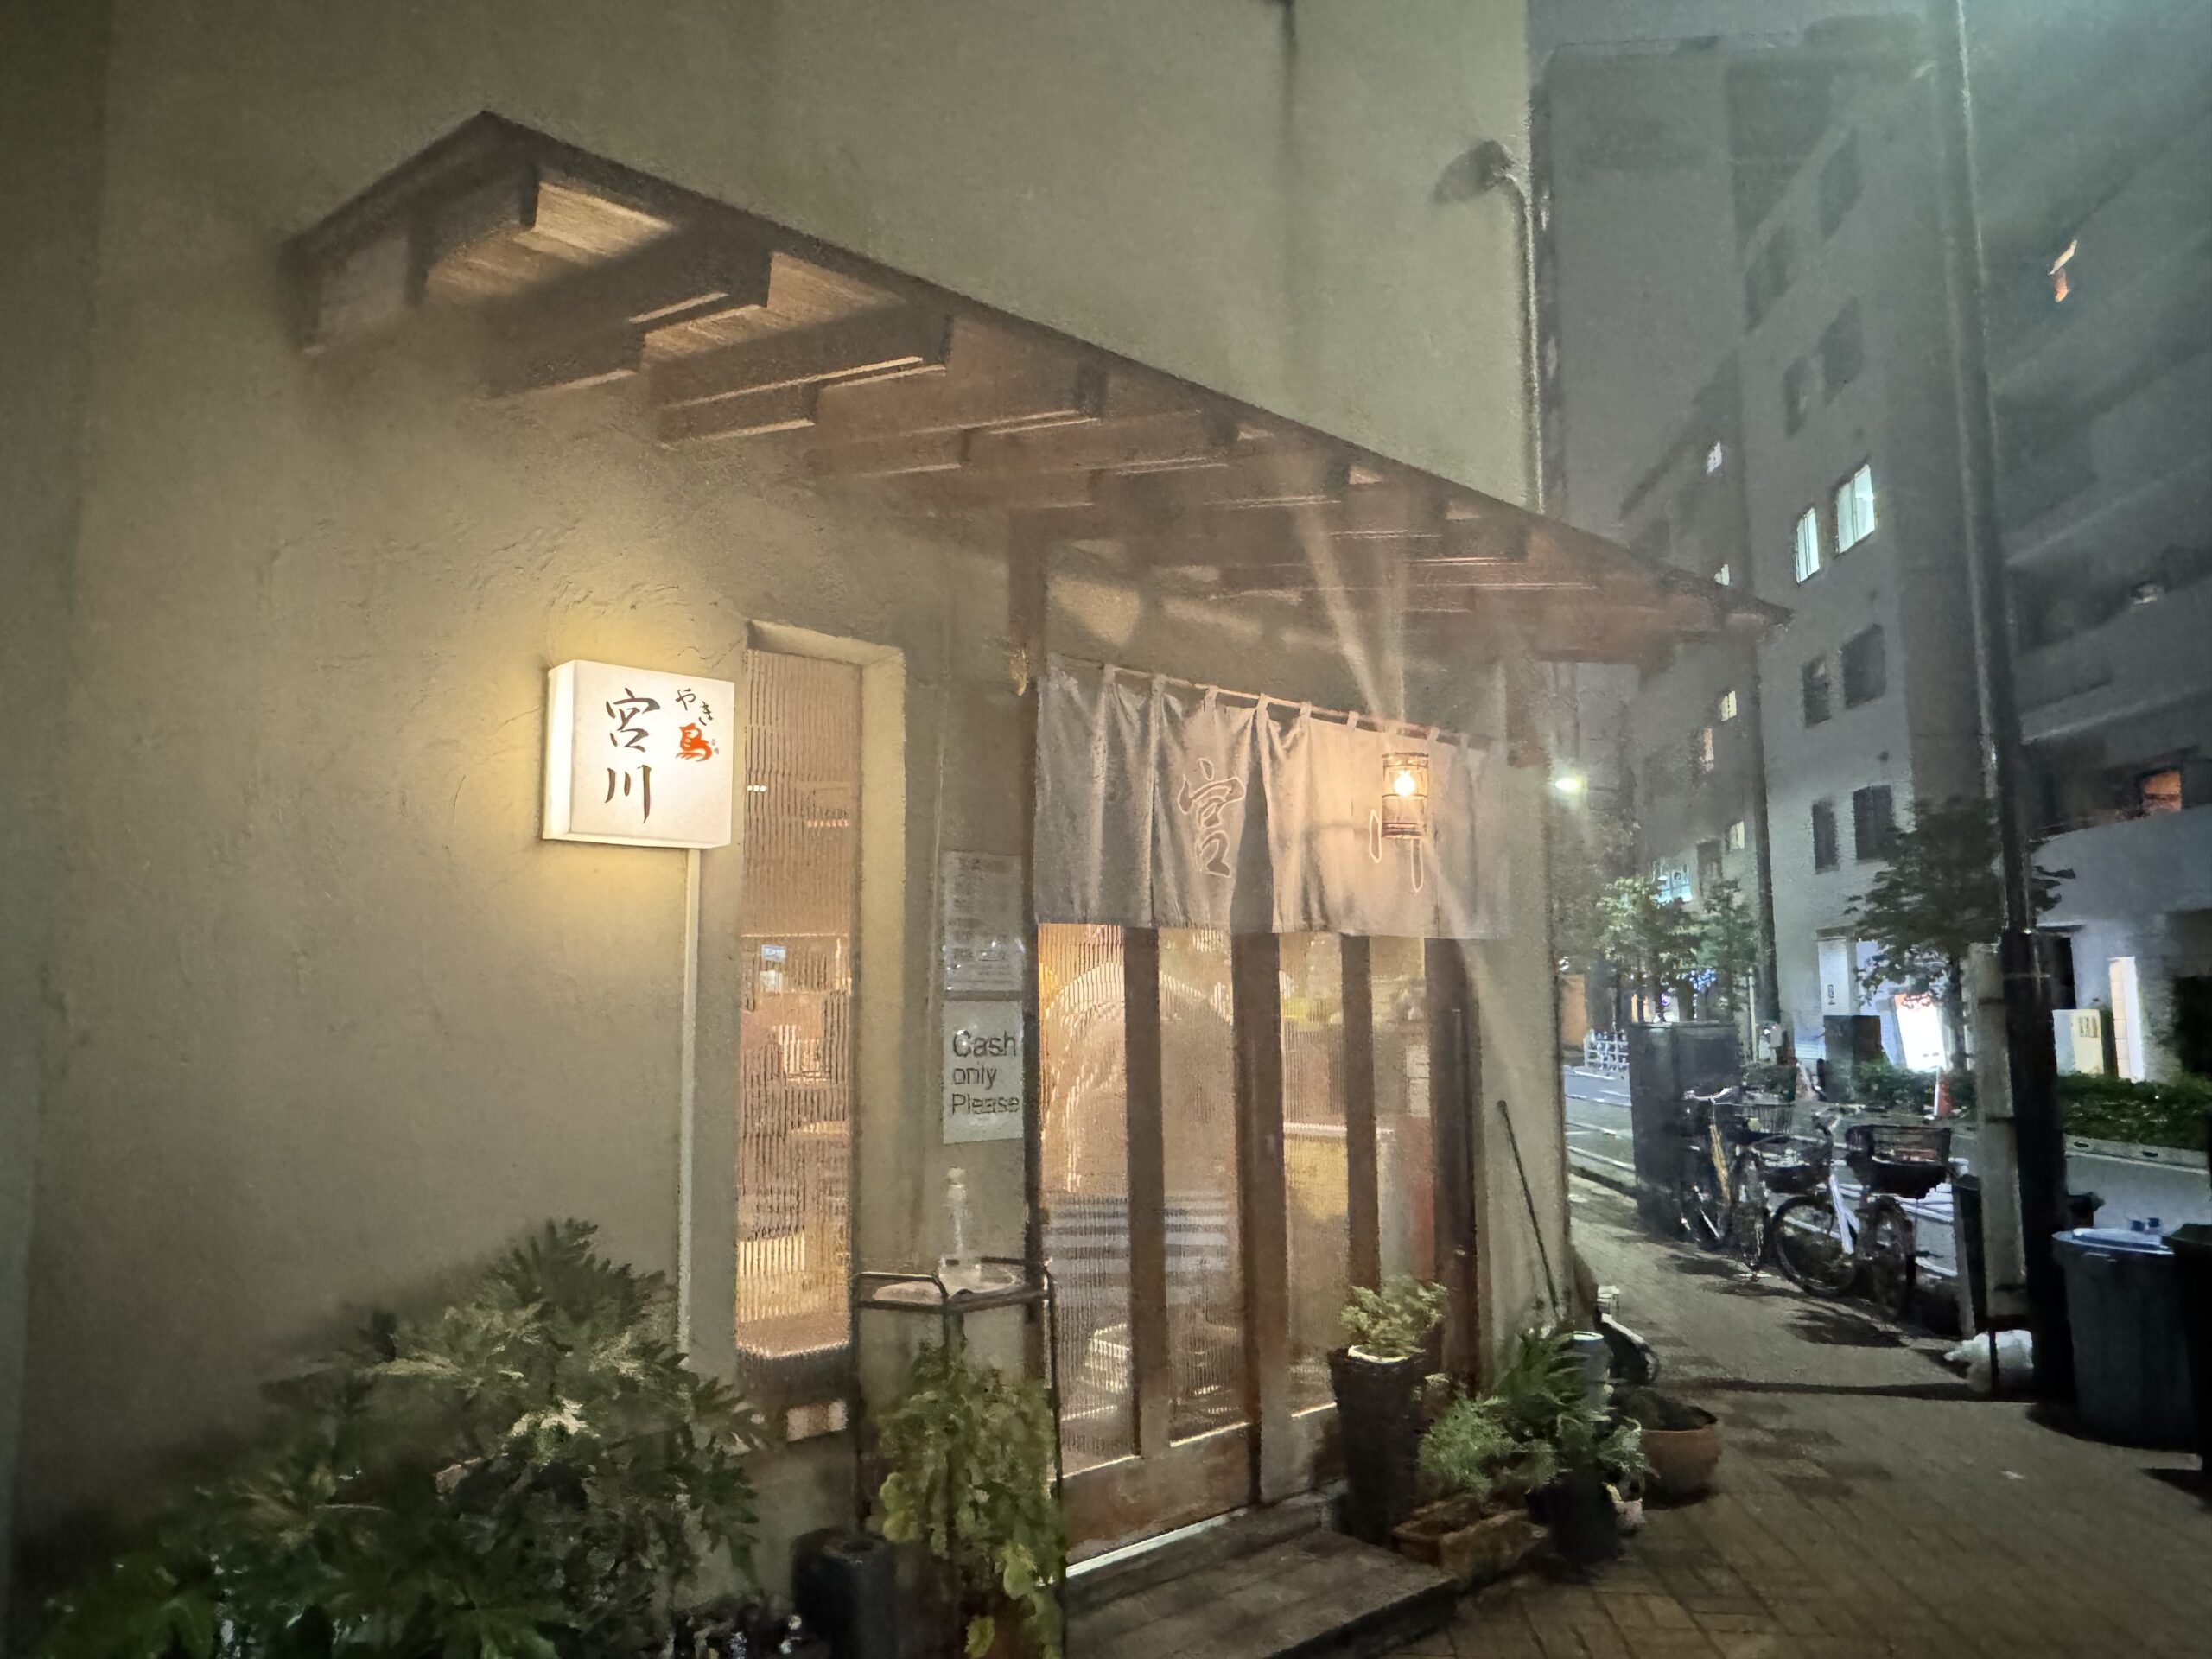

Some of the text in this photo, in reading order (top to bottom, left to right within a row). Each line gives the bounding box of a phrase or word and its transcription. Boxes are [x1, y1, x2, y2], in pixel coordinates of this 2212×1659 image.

[675, 688, 714, 762] やき鳥
[604, 687, 661, 824] 宮川
[953, 1029, 1017, 1058] Cash
[953, 1064, 997, 1090] only
[952, 1093, 1020, 1115] Please
